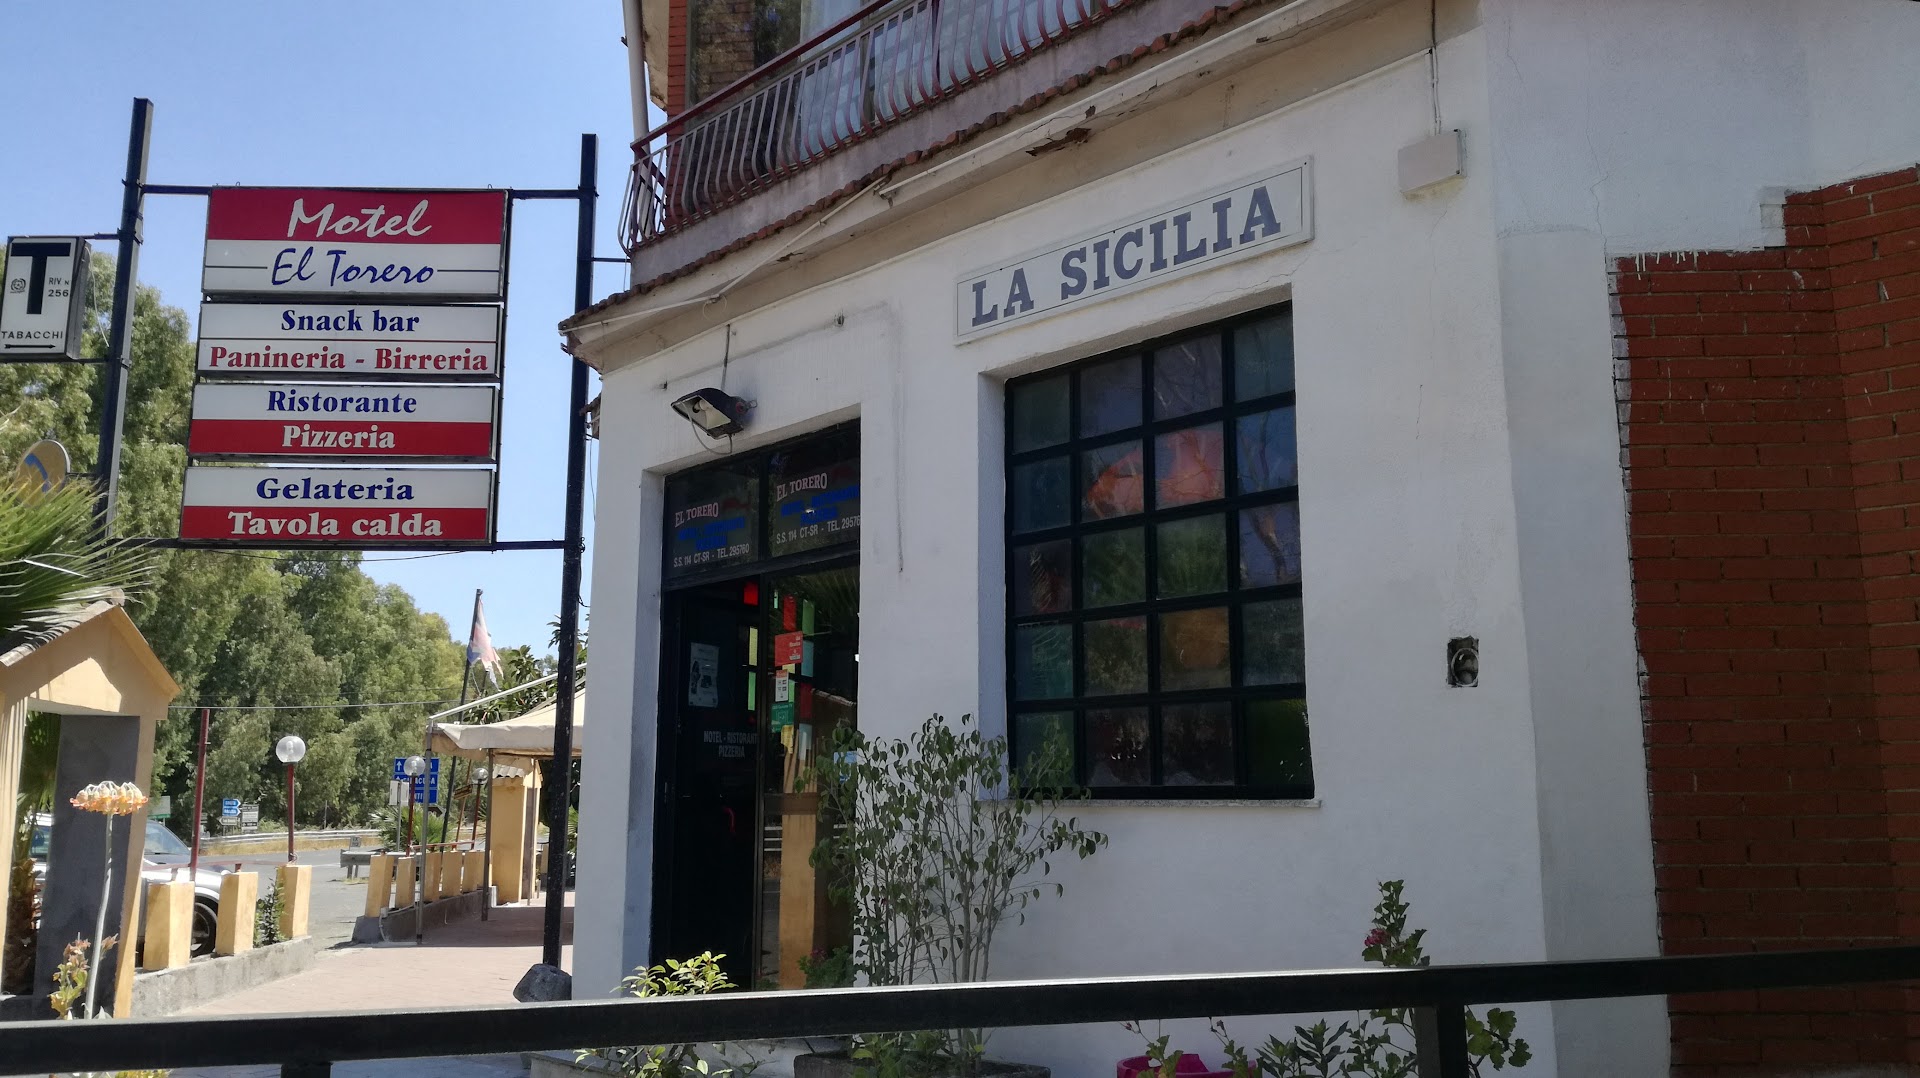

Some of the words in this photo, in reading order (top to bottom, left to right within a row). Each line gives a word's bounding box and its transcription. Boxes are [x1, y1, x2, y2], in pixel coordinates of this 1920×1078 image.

[287, 198, 433, 238] Motel
[272, 246, 316, 286] El
[326, 249, 434, 287] Torero
[972, 267, 1034, 327] LA
[1060, 185, 1281, 301] SICILIA
[11, 242, 72, 314] T
[48, 289, 69, 298] 256
[281, 309, 364, 332] Snack
[373, 310, 420, 332] bar
[1, 330, 63, 339] TABACCHI
[209, 345, 346, 370] Panineria
[374, 348, 488, 372] Birreria
[266, 390, 418, 414] Ristorante
[281, 424, 396, 449] Pizzeria
[256, 477, 414, 500] Gelateria
[776, 485, 788, 502] EL
[790, 472, 828, 494] TORERO
[227, 510, 340, 537] Tavola
[352, 512, 443, 537] calda
[674, 512, 684, 528] EL
[686, 502, 719, 521] TORERO
[800, 524, 818, 539] CT-SR
[694, 551, 710, 564] CT-SR
[729, 544, 750, 557] 295760
